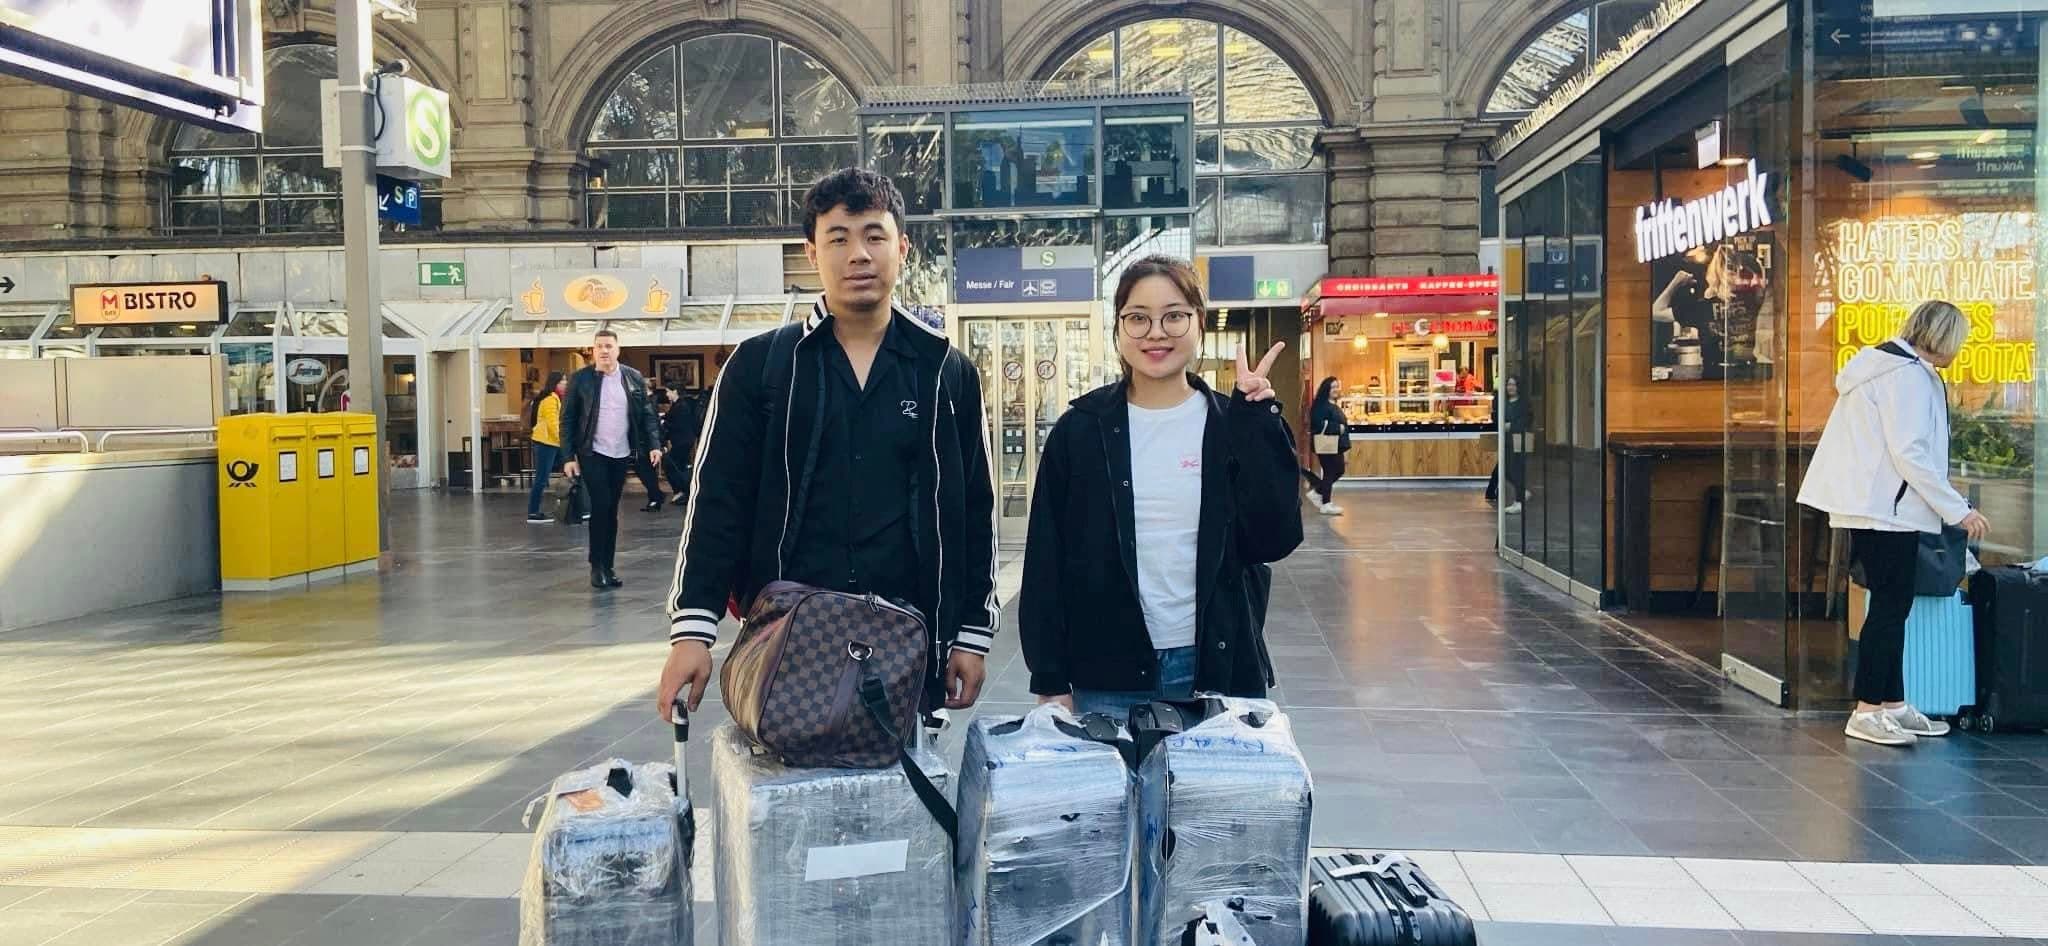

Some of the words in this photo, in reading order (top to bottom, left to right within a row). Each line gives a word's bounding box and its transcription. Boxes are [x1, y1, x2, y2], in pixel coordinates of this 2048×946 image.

[415, 98, 441, 159] S
[394, 185, 404, 204] S
[1635, 157, 1772, 264] frittenwerk
[1839, 220, 1962, 263] HATERS
[1041, 250, 1055, 266] S
[966, 280, 992, 289] Messe
[999, 280, 1015, 289] Fair
[1838, 263, 1952, 304] GONNA
[102, 294, 119, 309] M
[124, 291, 197, 310] BISTRO
